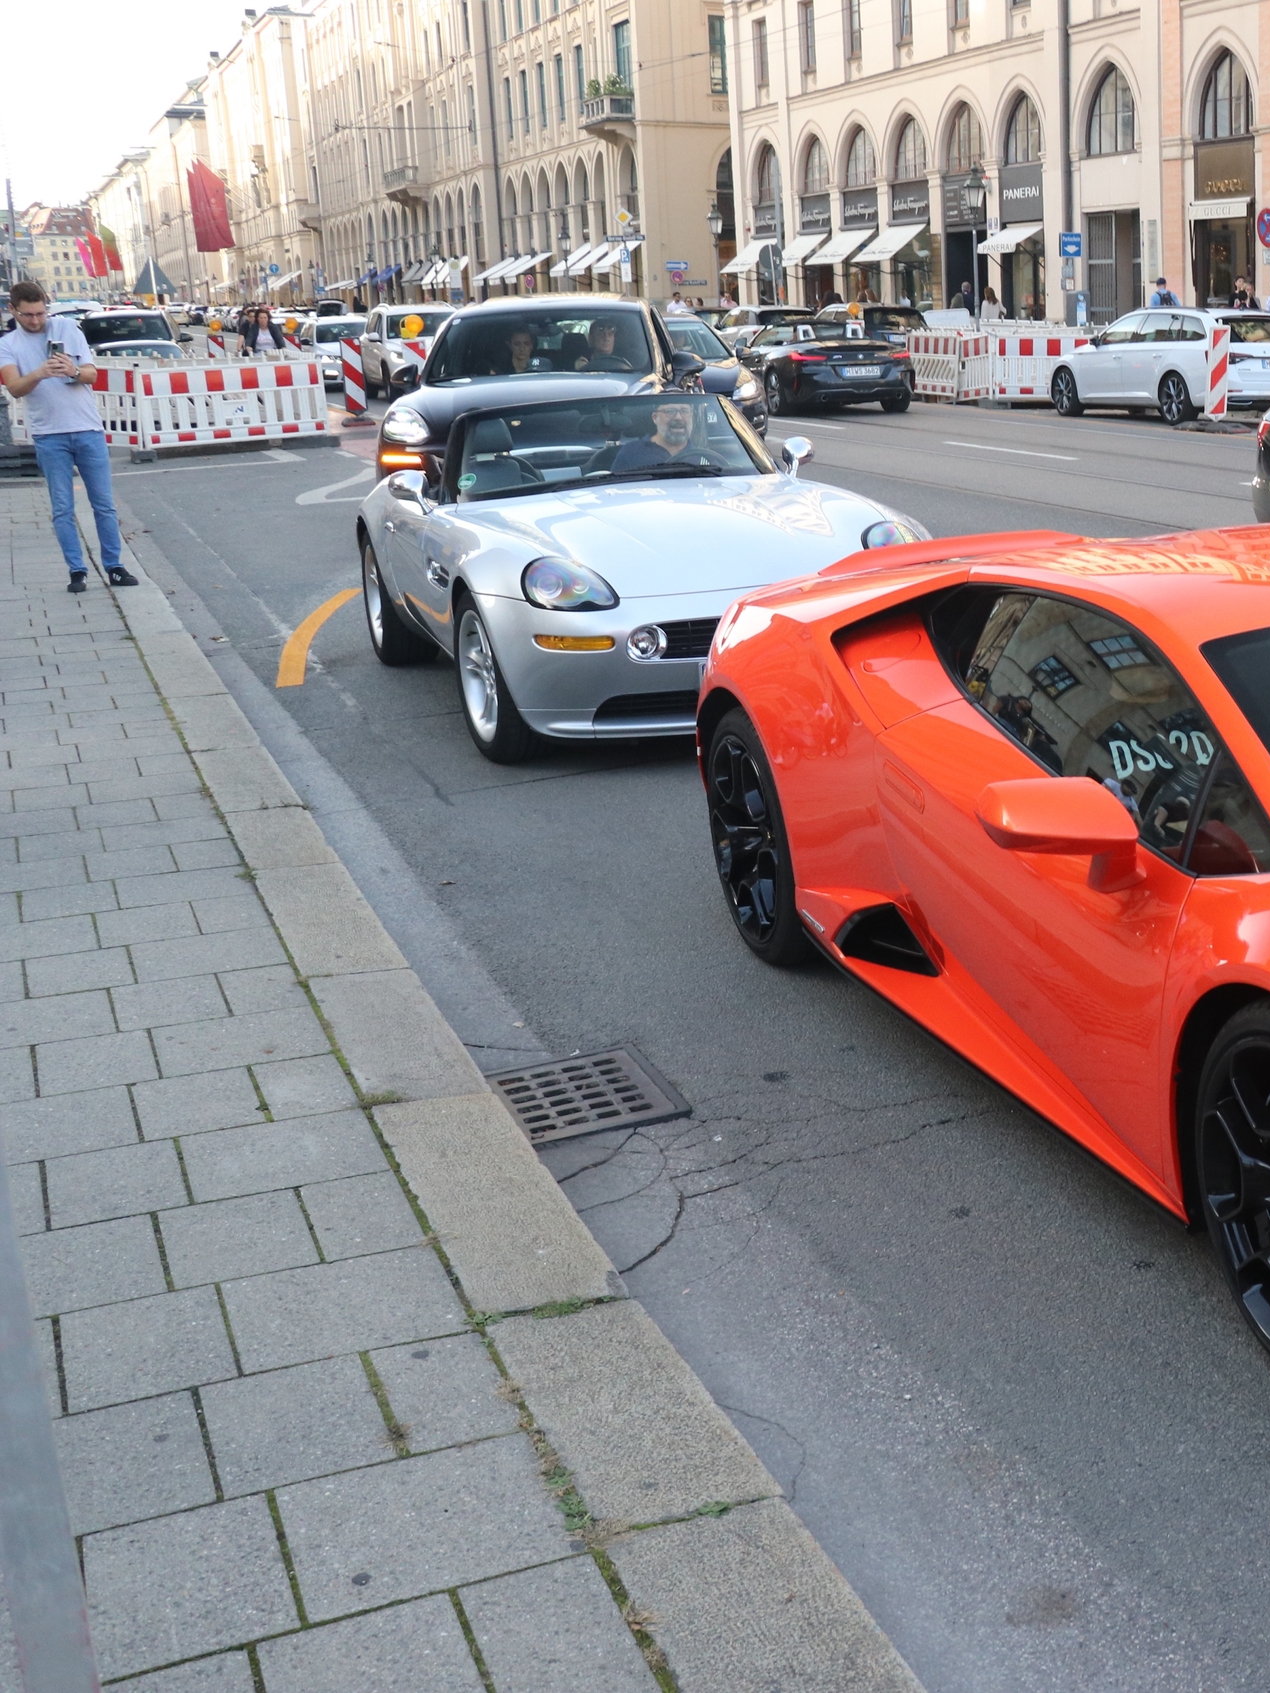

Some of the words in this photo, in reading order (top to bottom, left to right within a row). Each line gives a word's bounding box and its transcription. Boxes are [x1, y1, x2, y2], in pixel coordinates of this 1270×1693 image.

[1003, 186, 1040, 200] PANERAI
[1203, 205, 1231, 217] GUCCI
[982, 243, 1012, 252] PANERAI
